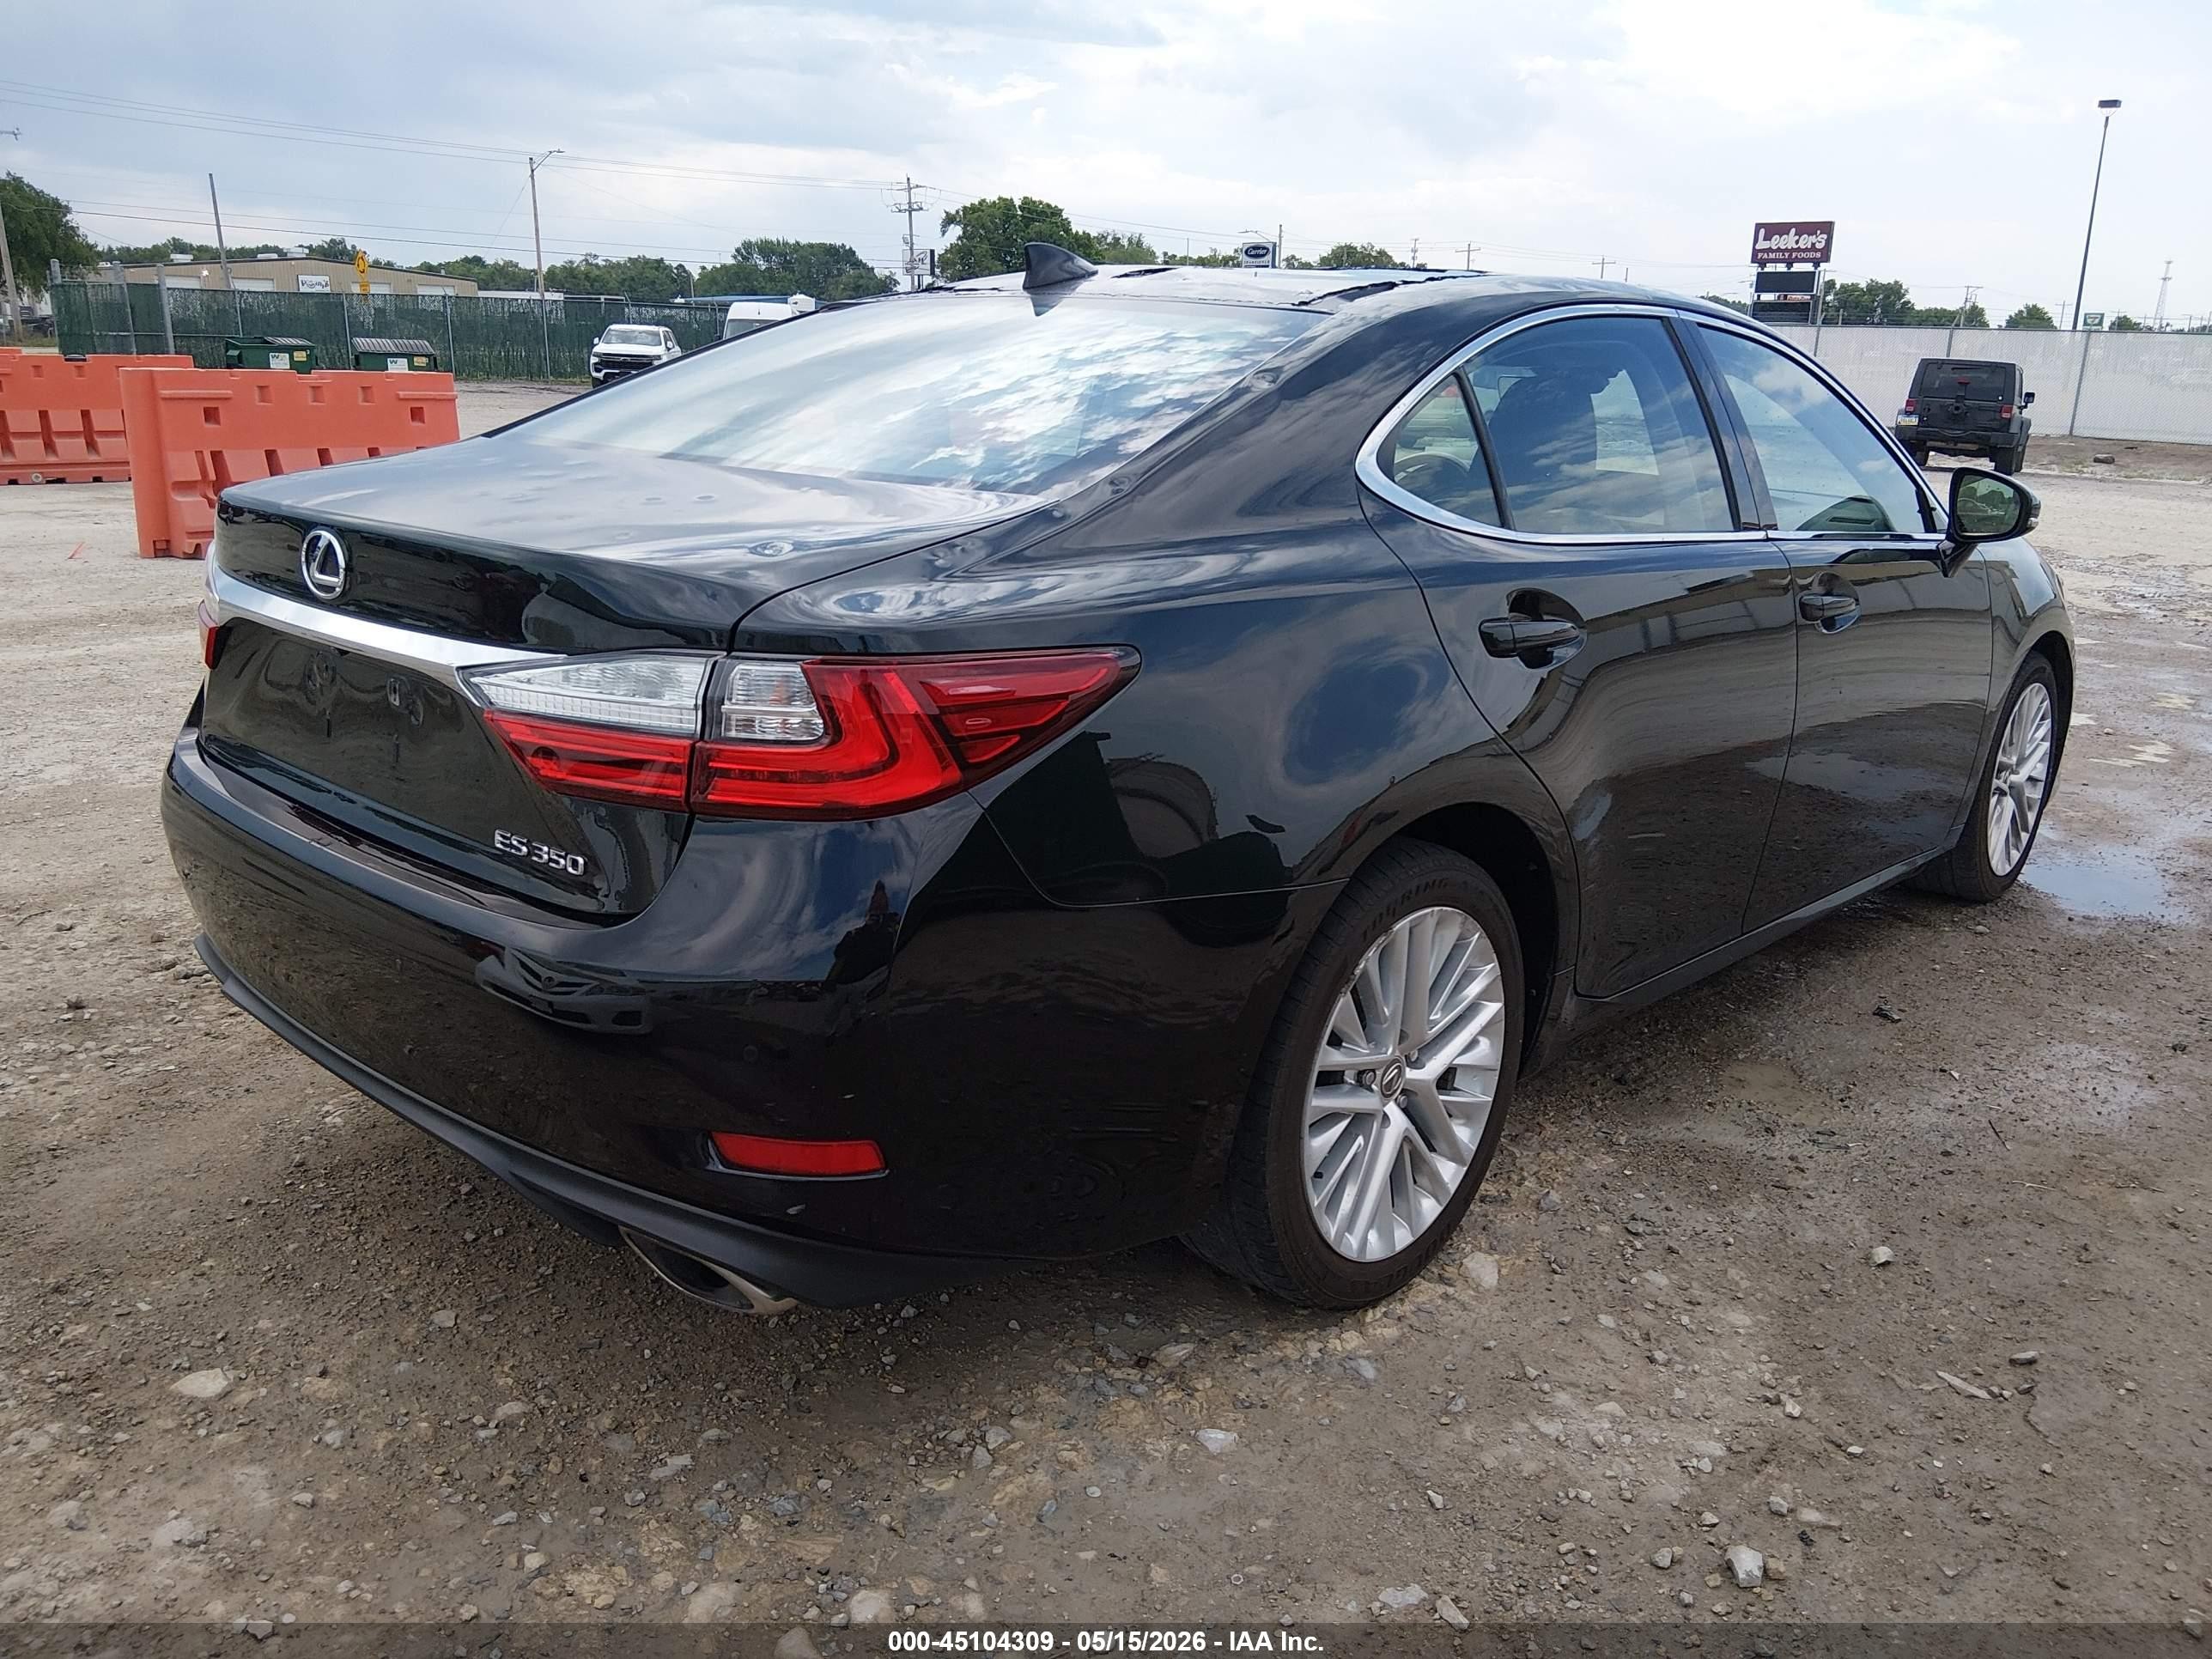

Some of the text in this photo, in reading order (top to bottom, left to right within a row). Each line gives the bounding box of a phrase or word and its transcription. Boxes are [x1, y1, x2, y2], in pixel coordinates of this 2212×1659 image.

[1754, 228, 1827, 250] Leeker's
[494, 829, 585, 875] ES 350
